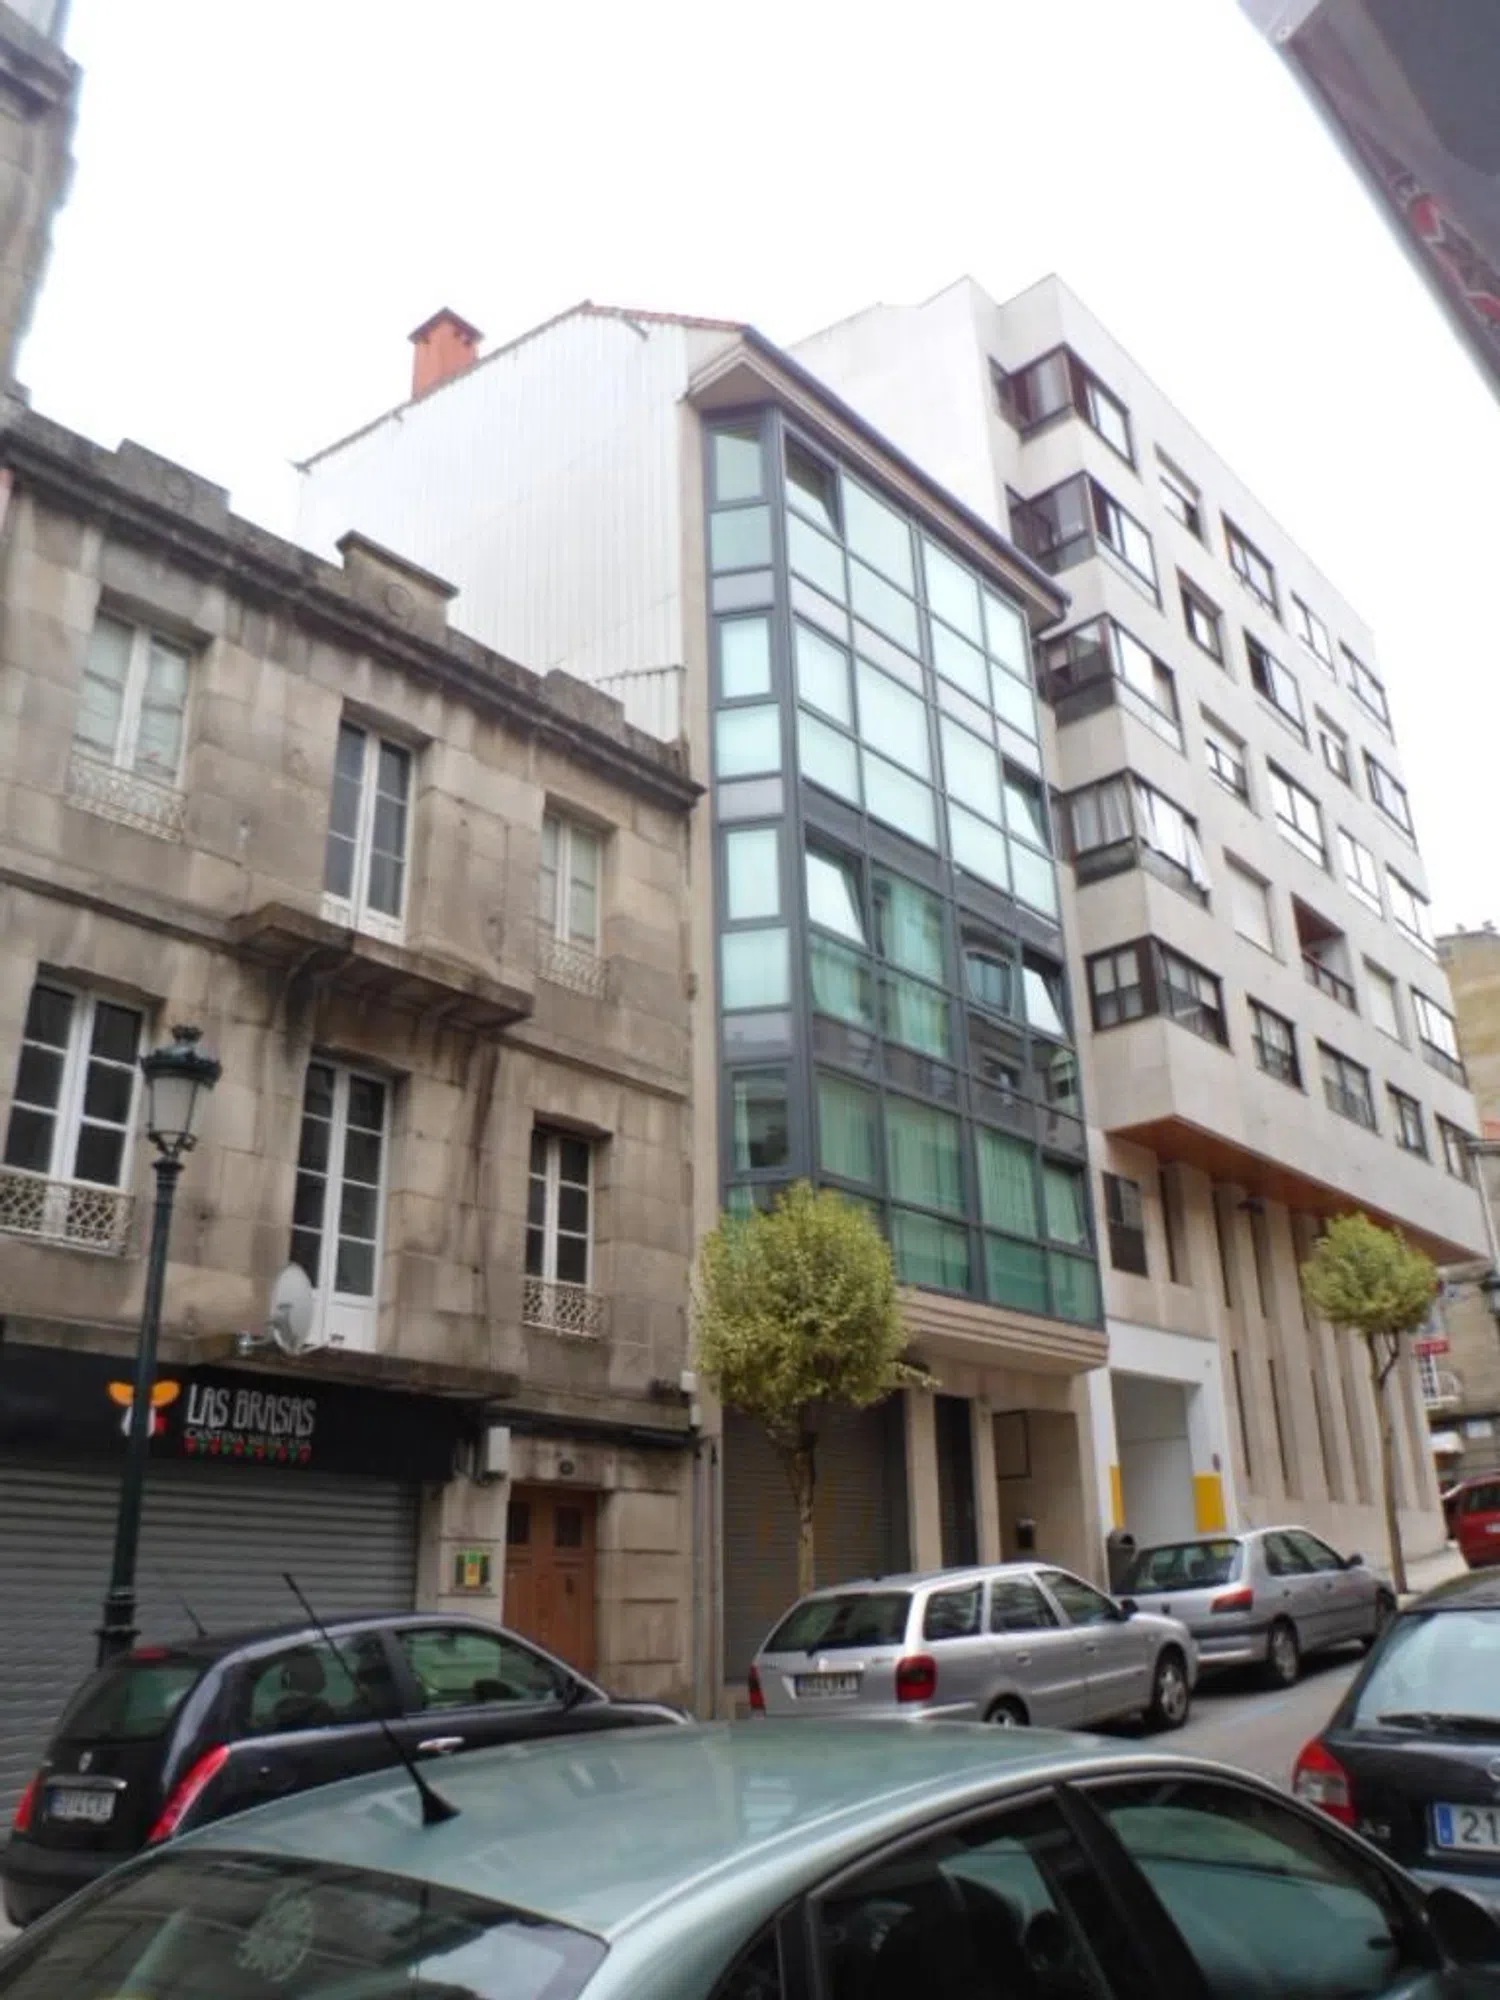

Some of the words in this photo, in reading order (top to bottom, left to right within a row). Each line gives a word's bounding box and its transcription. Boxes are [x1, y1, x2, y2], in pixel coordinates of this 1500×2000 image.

[187, 1383, 230, 1427] LAS
[233, 1390, 316, 1436] BRASAS
[1461, 1810, 1499, 1845] 21
